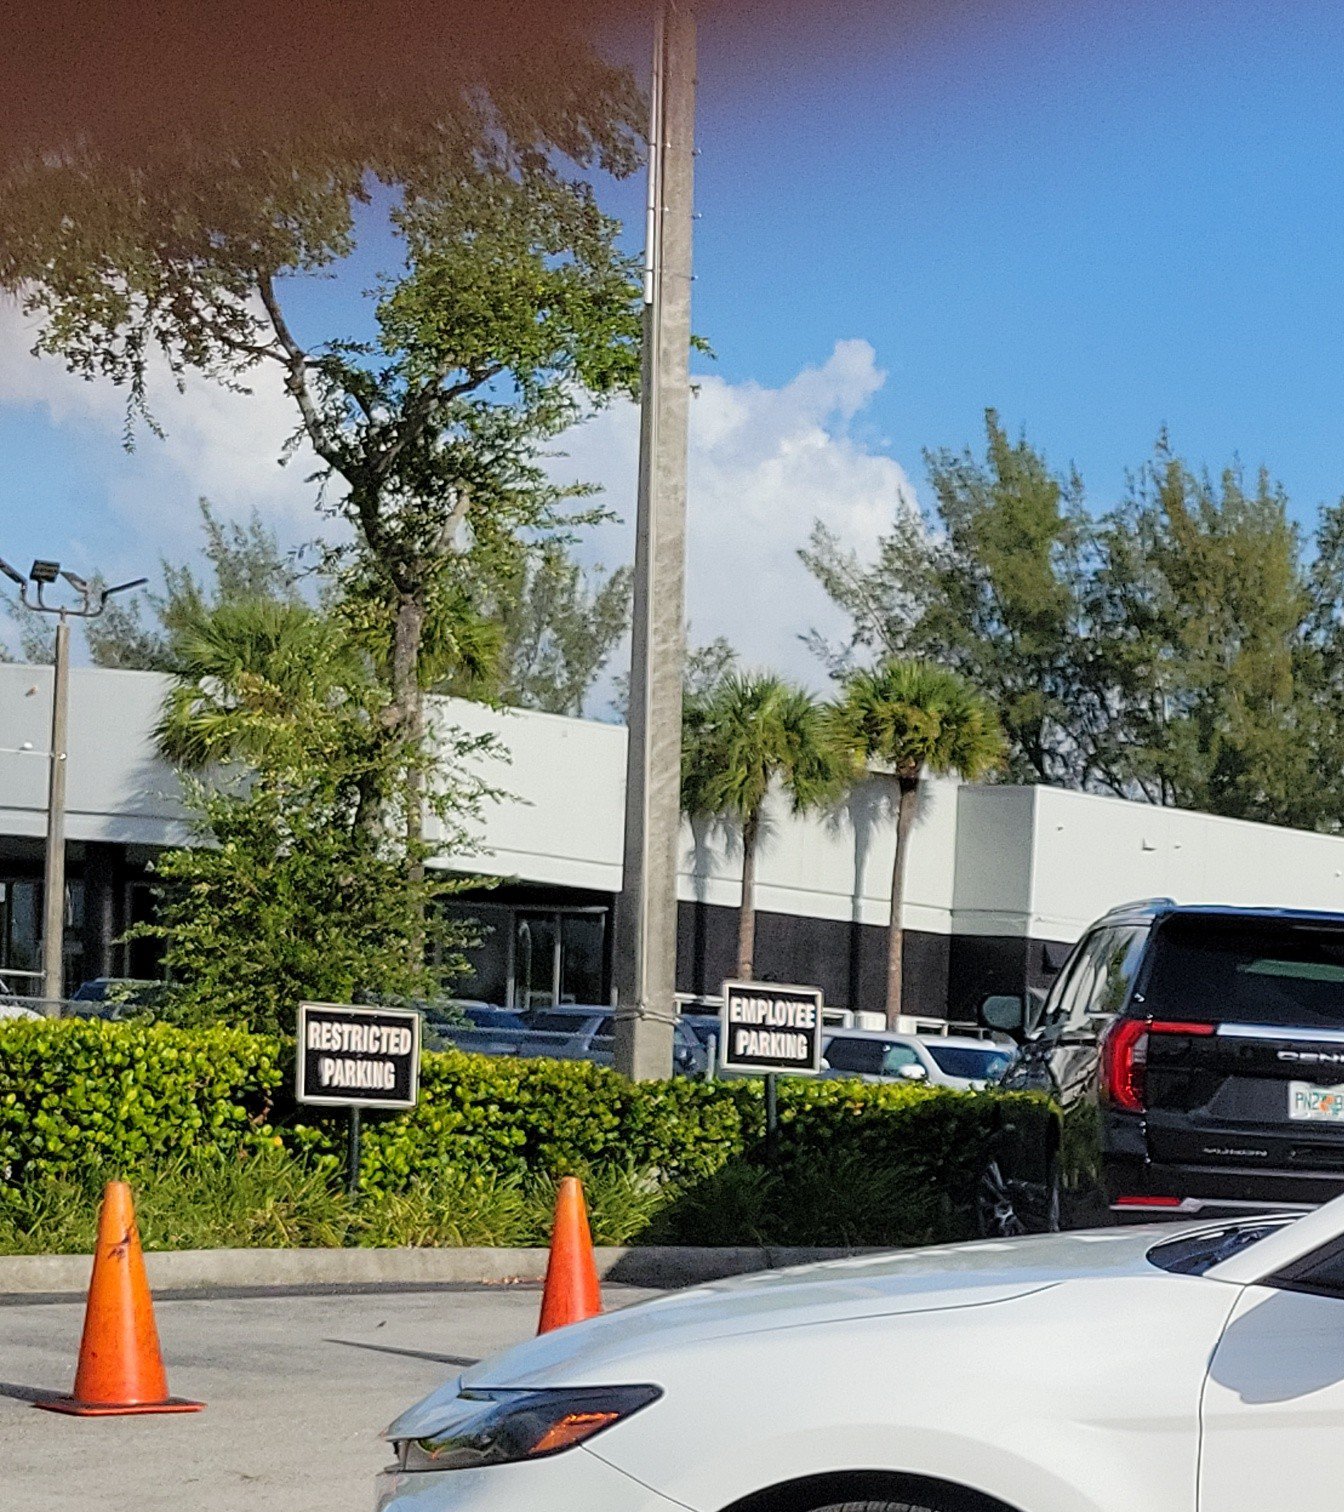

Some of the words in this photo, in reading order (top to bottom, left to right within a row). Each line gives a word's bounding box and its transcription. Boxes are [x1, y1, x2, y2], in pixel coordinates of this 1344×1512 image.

[729, 996, 816, 1029] EMPLOYEE
[307, 1021, 412, 1056] RESTRICTED
[734, 1028, 808, 1060] PARKING
[320, 1057, 396, 1091] PARKING
